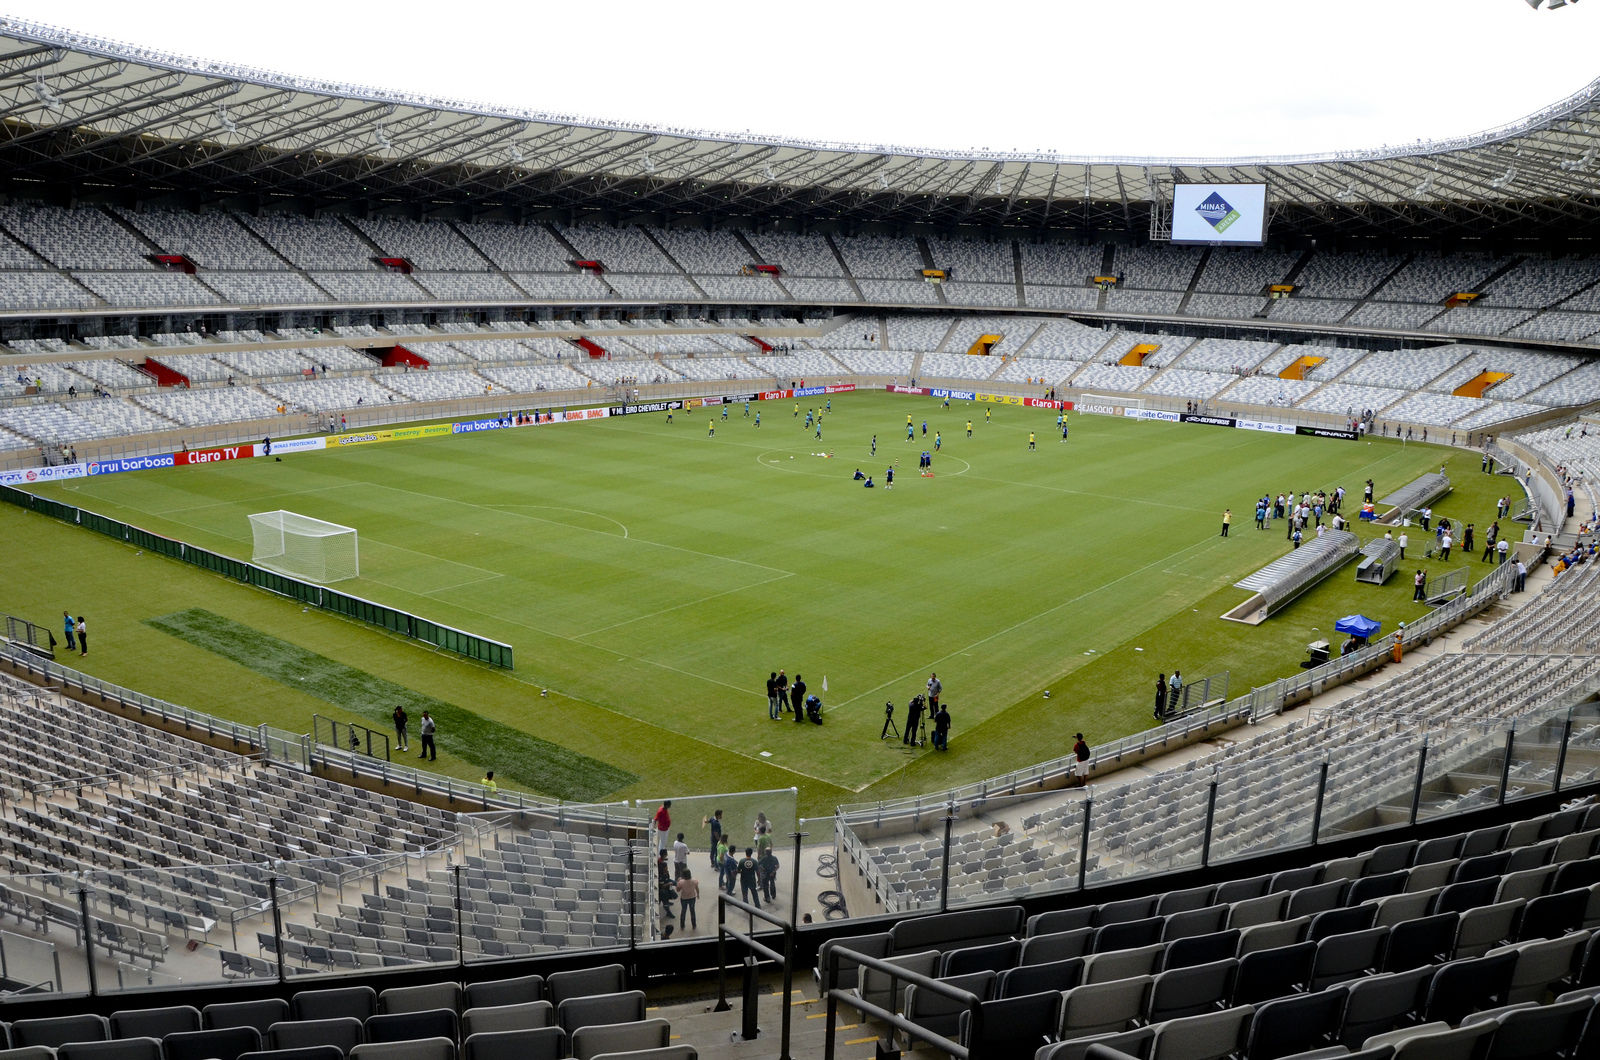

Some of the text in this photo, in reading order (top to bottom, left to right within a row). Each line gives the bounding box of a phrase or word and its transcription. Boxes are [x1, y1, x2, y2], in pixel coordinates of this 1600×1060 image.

[1218, 213, 1238, 230] ARENA
[764, 391, 779, 400] Claro
[780, 390, 787, 398] TV
[805, 386, 825, 396] barbosa
[951, 391, 972, 399] MEDIC
[1031, 398, 1052, 408] Claro
[616, 404, 638, 415] MIEIRO
[638, 402, 668, 412] CHEVROLET
[567, 409, 603, 420] BMG BMG
[1157, 411, 1178, 420] Cemil
[461, 418, 509, 432] rui barboa
[1200, 416, 1231, 426] OLYMPIKUS
[1315, 430, 1354, 439] PENALTY
[188, 447, 239, 464] Claro TV
[101, 457, 174, 473] rui barbosa
[39, 468, 53, 477] 40
